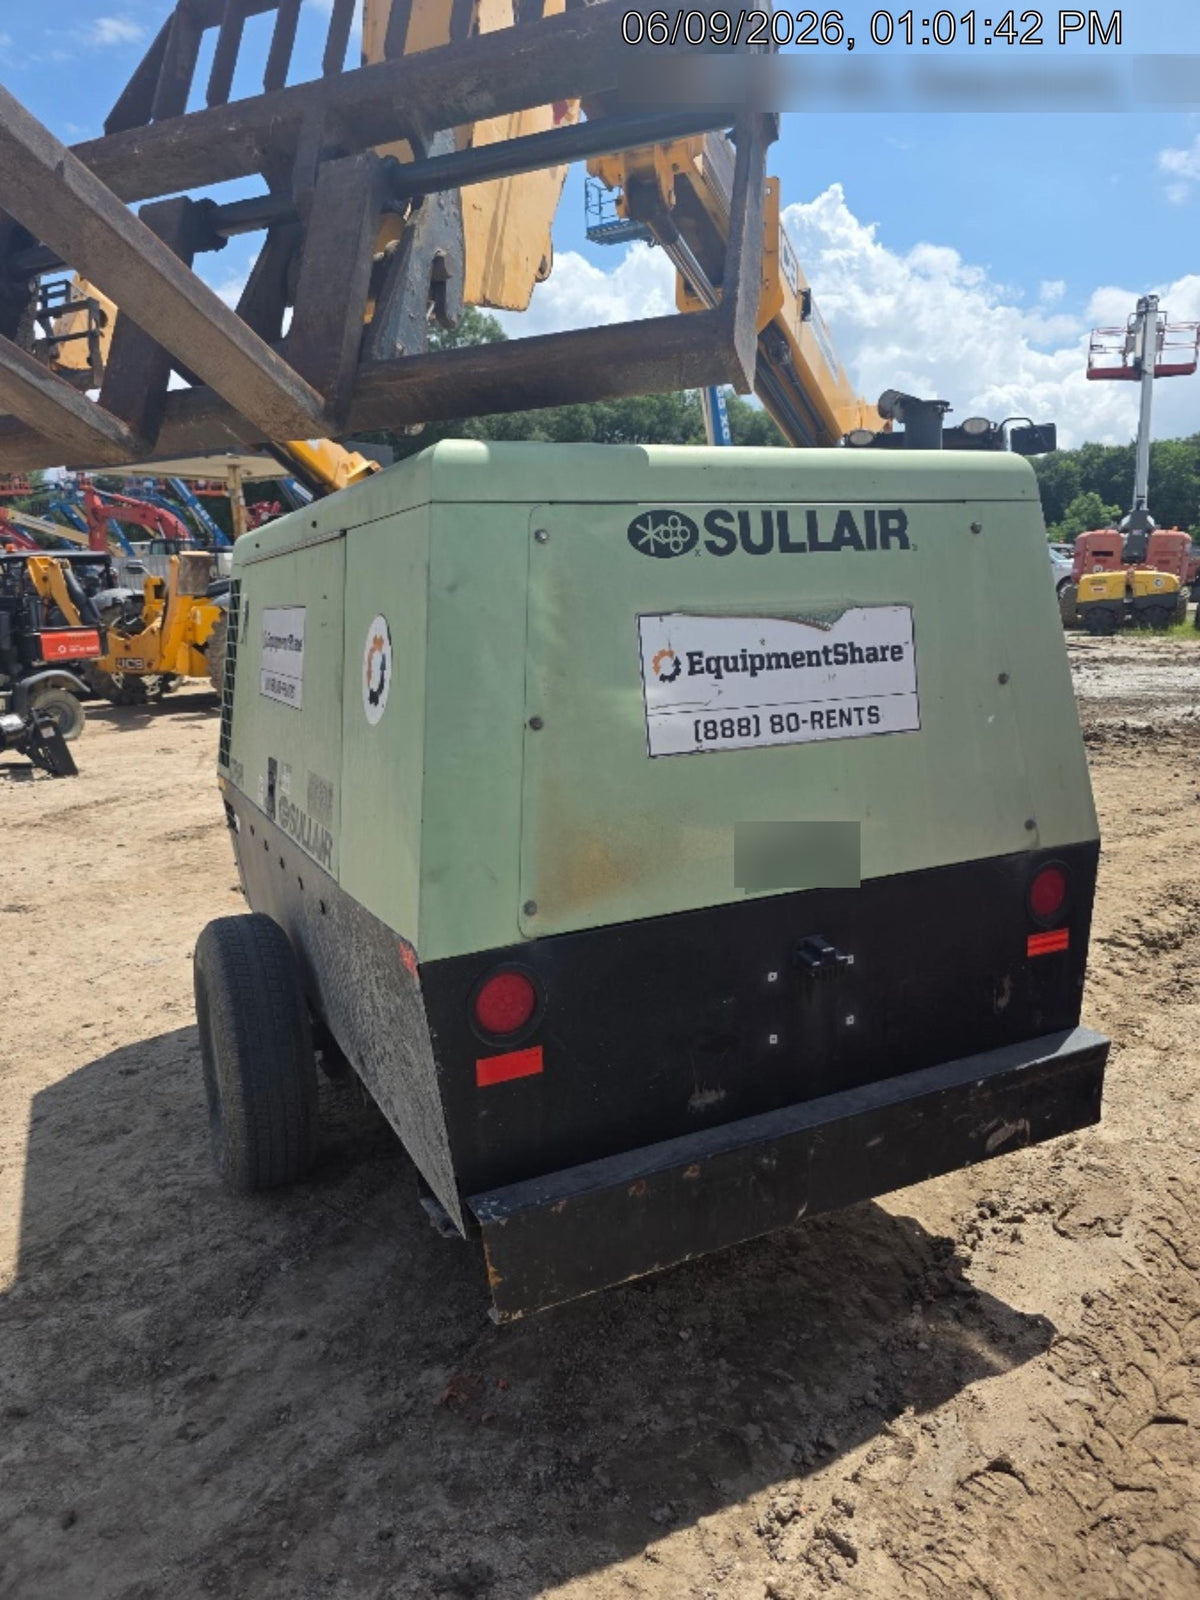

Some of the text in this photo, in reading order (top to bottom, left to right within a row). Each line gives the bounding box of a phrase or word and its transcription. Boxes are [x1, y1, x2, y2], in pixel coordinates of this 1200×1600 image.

[704, 508, 911, 556] SULLAIR
[686, 642, 904, 679] EquipmentShare
[694, 705, 881, 743] (888) 80-RENTS
